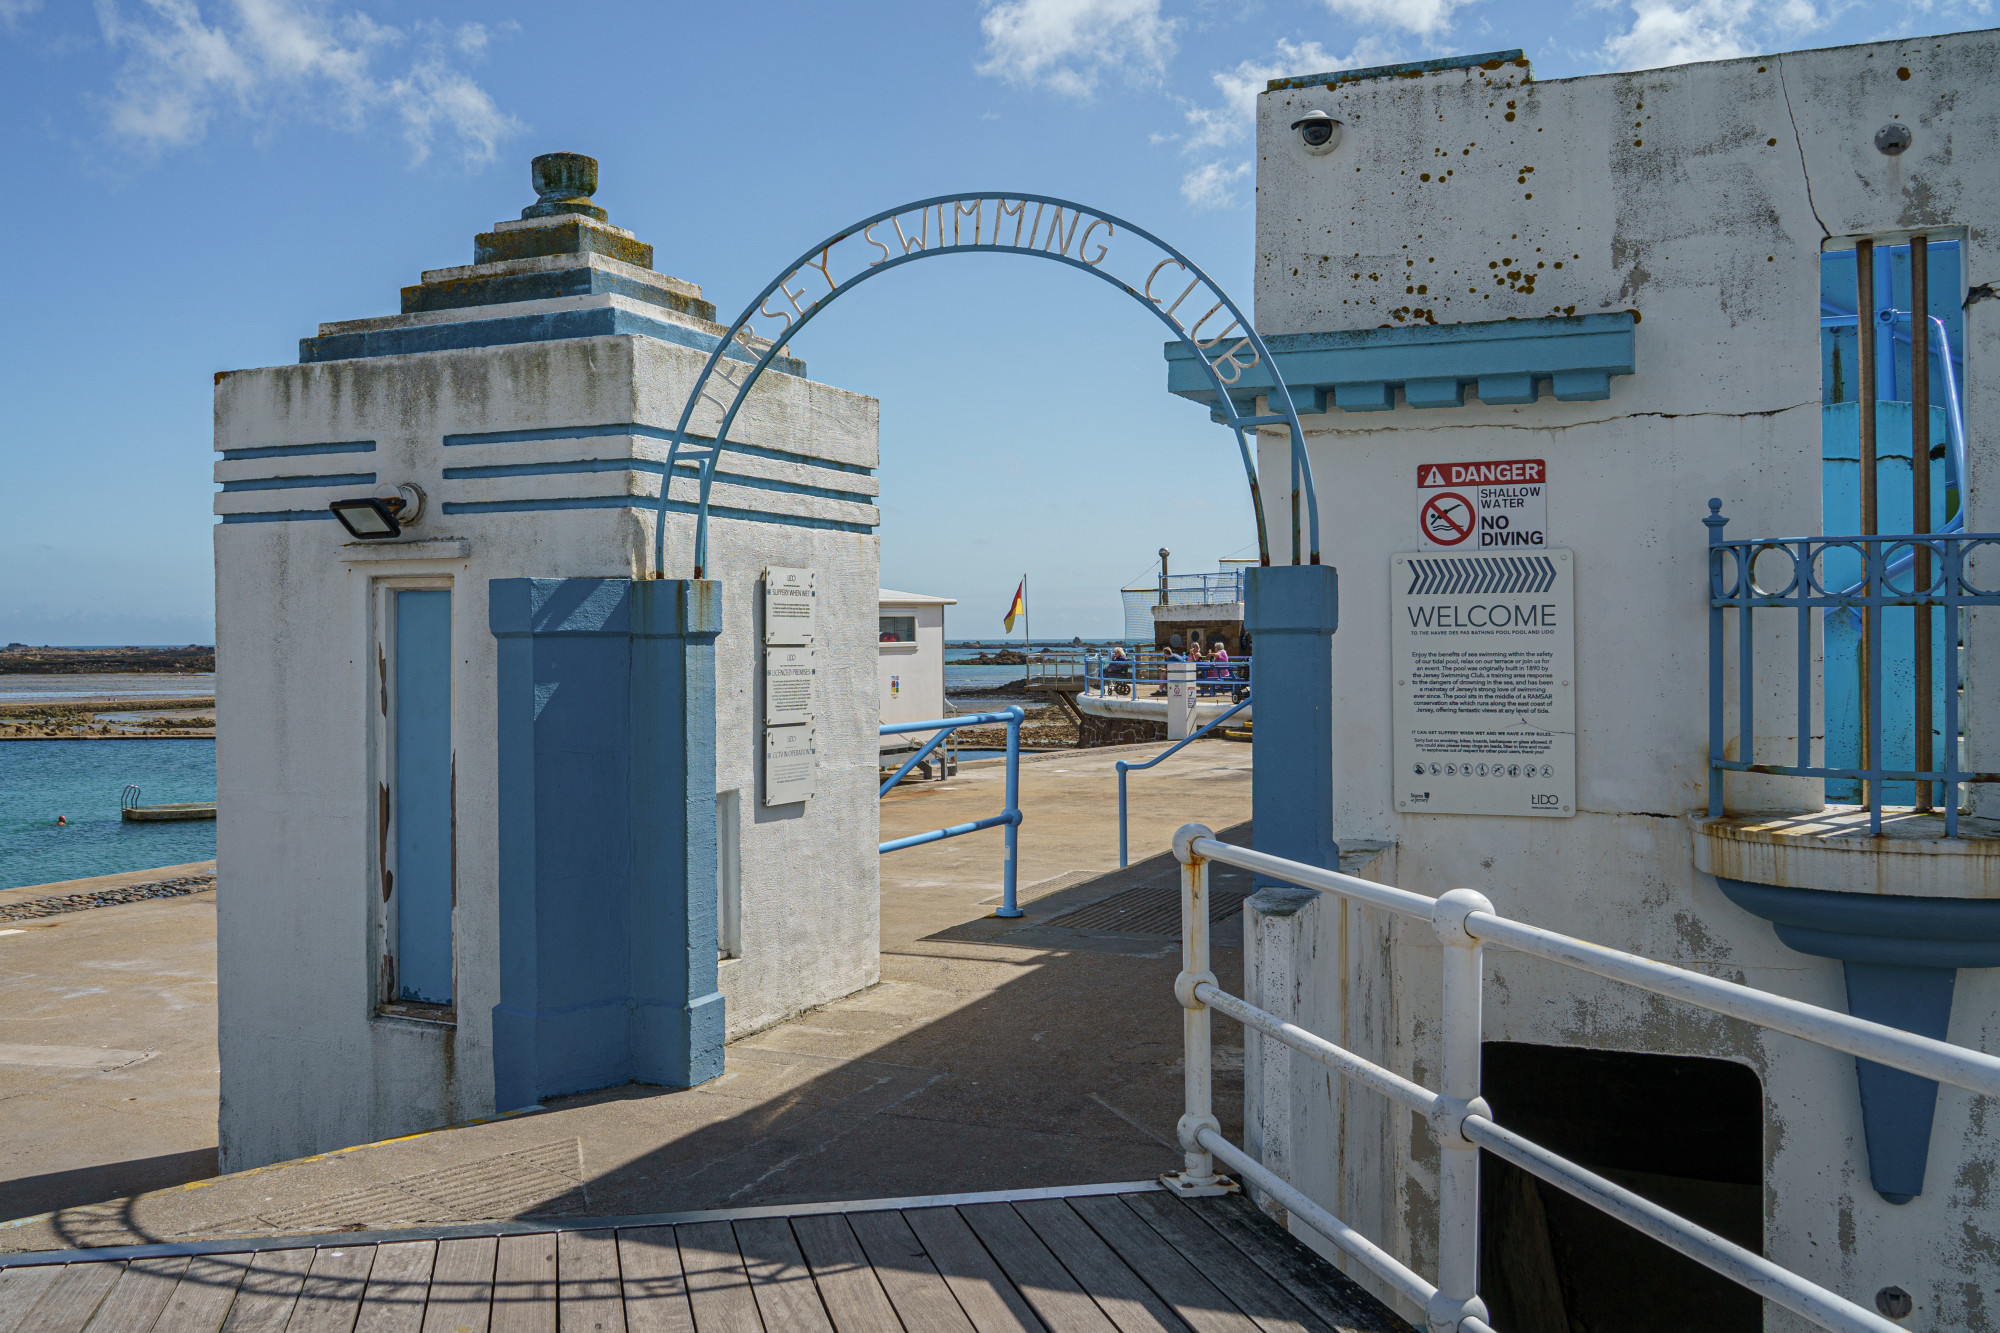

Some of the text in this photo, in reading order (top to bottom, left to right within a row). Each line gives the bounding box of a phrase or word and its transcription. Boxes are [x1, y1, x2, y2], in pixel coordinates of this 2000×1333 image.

[692, 197, 1262, 425] JERSEY SWIMMING CLUB
[1452, 464, 1538, 483] DANGER
[1480, 487, 1541, 498] SHALLOW
[1480, 498, 1525, 508] WATER
[1481, 515, 1510, 530] NO
[1481, 530, 1544, 547] DIVING
[1408, 604, 1556, 628] WELCOME
